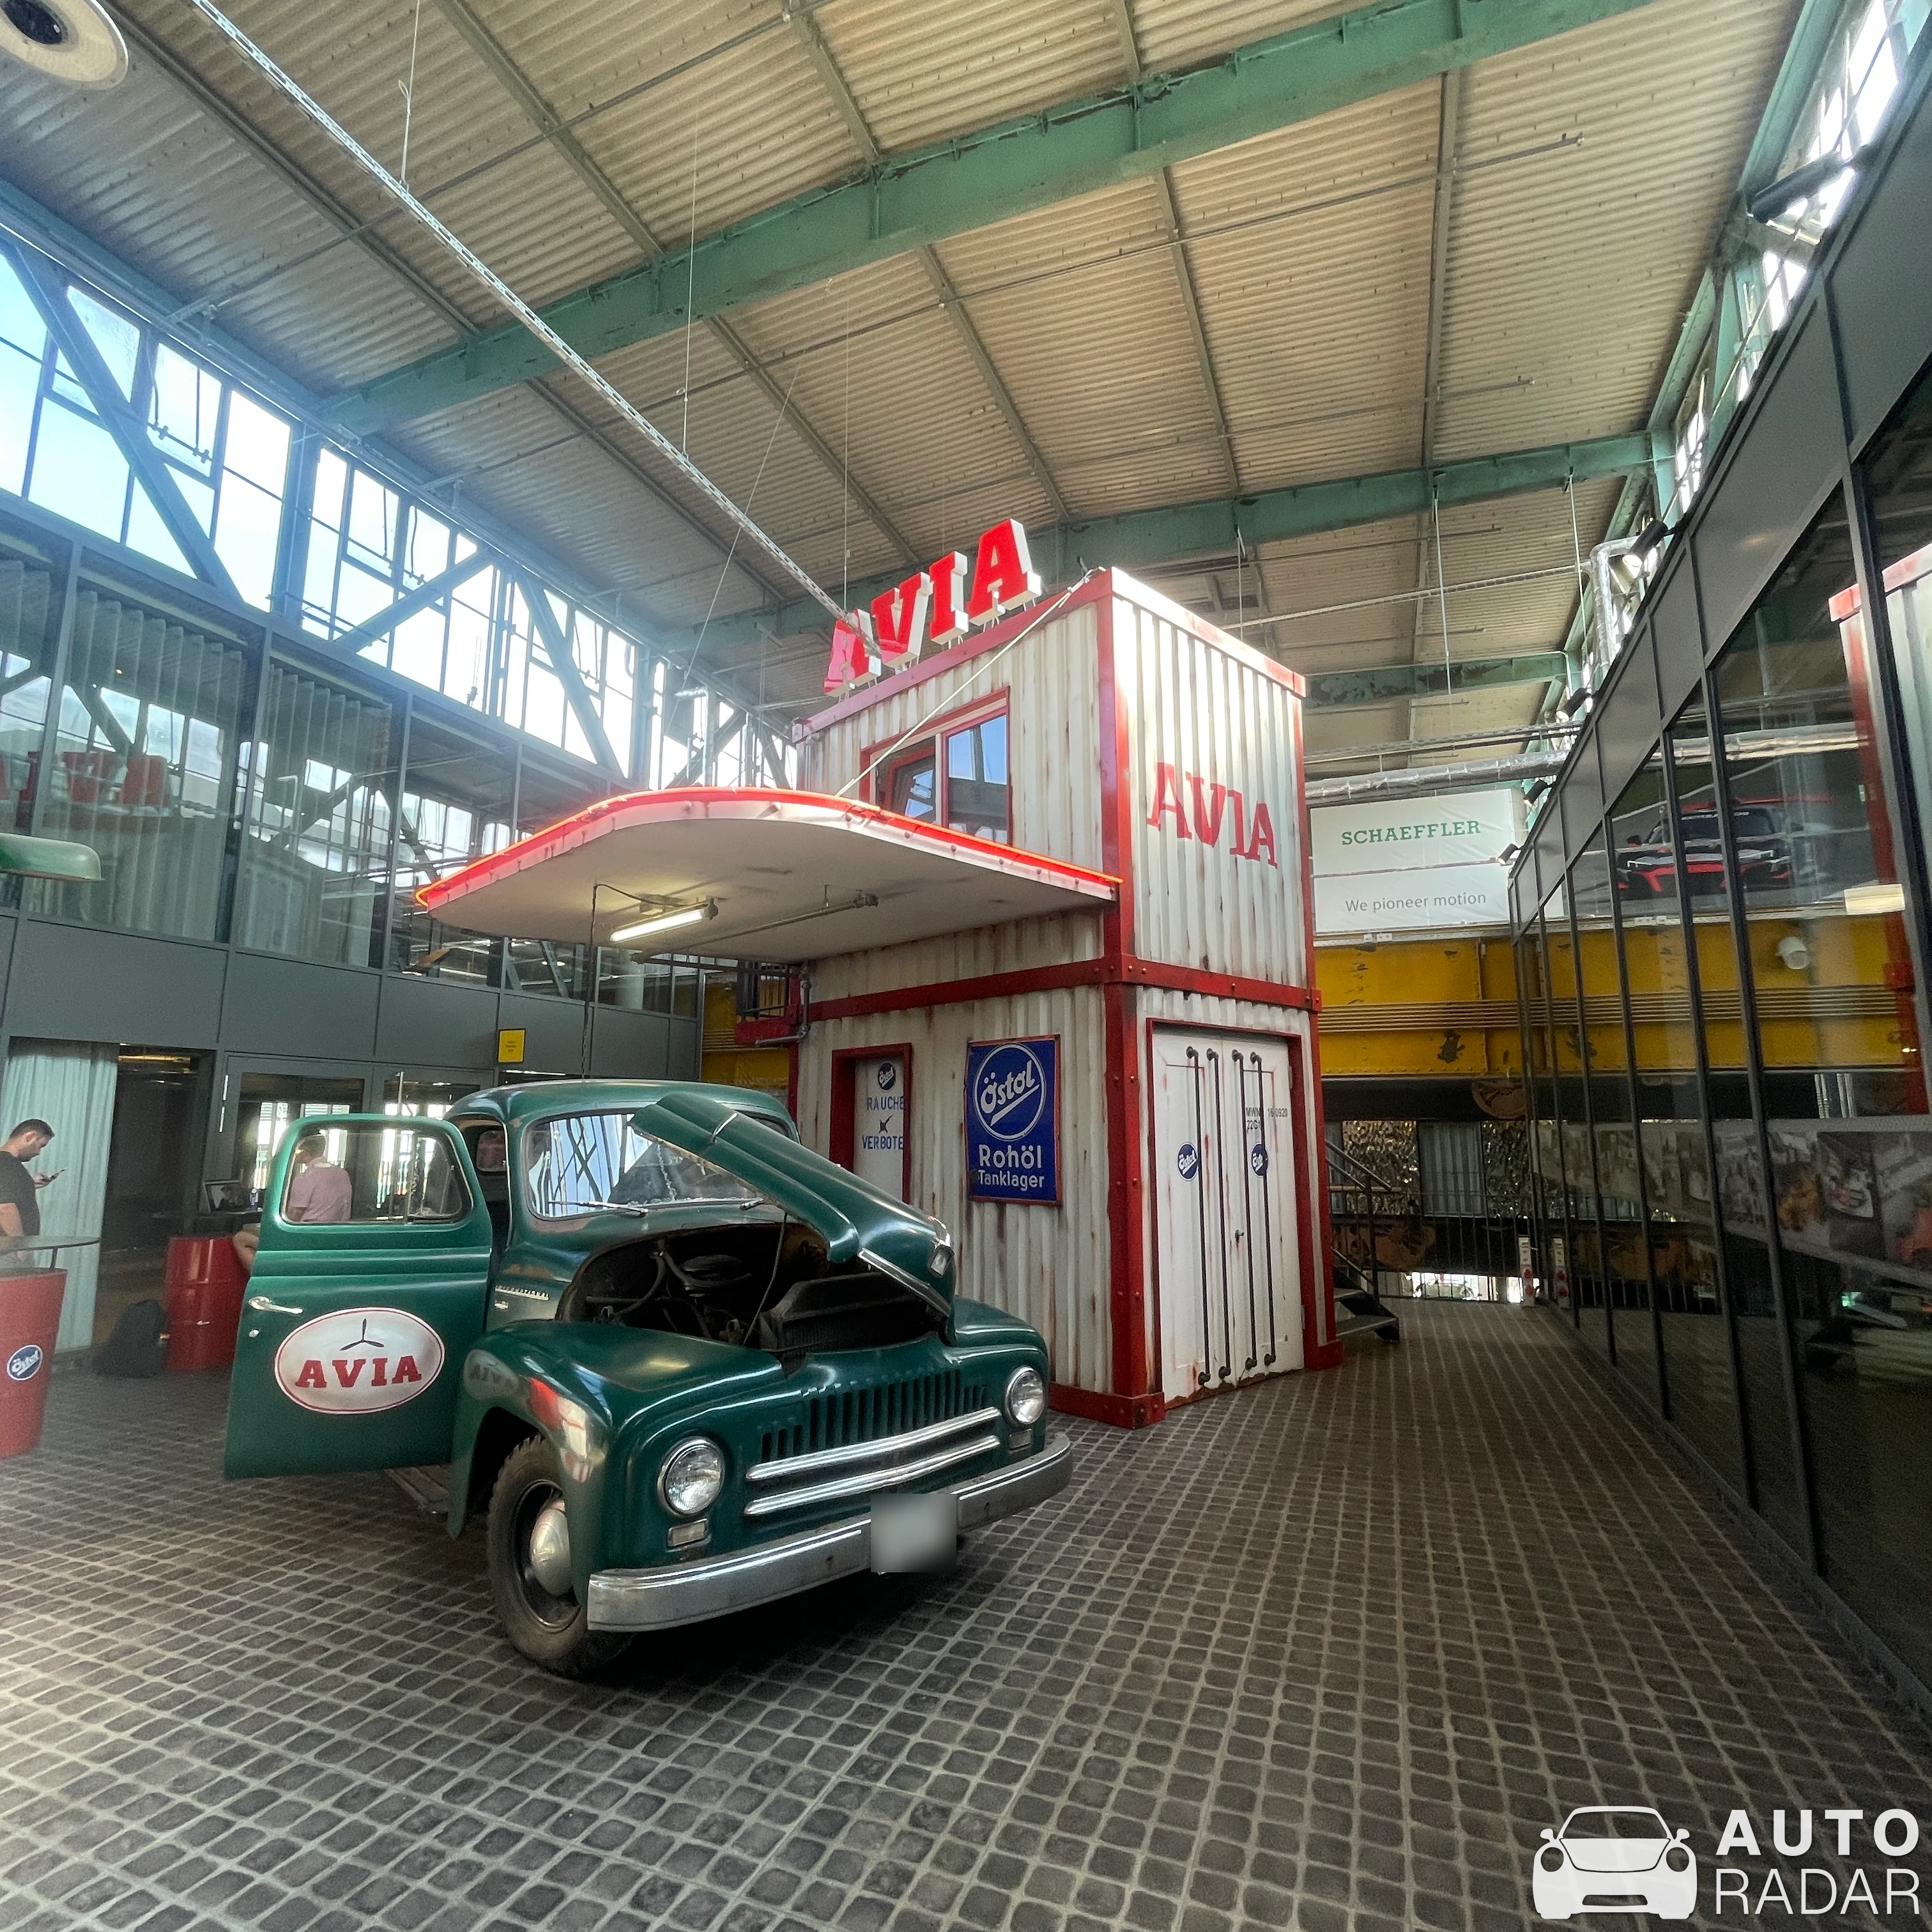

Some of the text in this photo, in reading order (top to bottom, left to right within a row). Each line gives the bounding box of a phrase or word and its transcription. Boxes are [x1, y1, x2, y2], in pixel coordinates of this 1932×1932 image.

[824, 518, 1041, 697] AVIA
[1147, 762, 1278, 868] AVIA
[1341, 820, 1481, 845] SCHAEFFLER
[1346, 893, 1487, 914] We pioneer motion
[866, 1096, 904, 1110] RAUCHE
[862, 1135, 903, 1150] VERBOTE
[978, 1144, 1042, 1169] Rohöl
[978, 1169, 1045, 1192] Tanklager
[295, 1354, 422, 1390] AVIA
